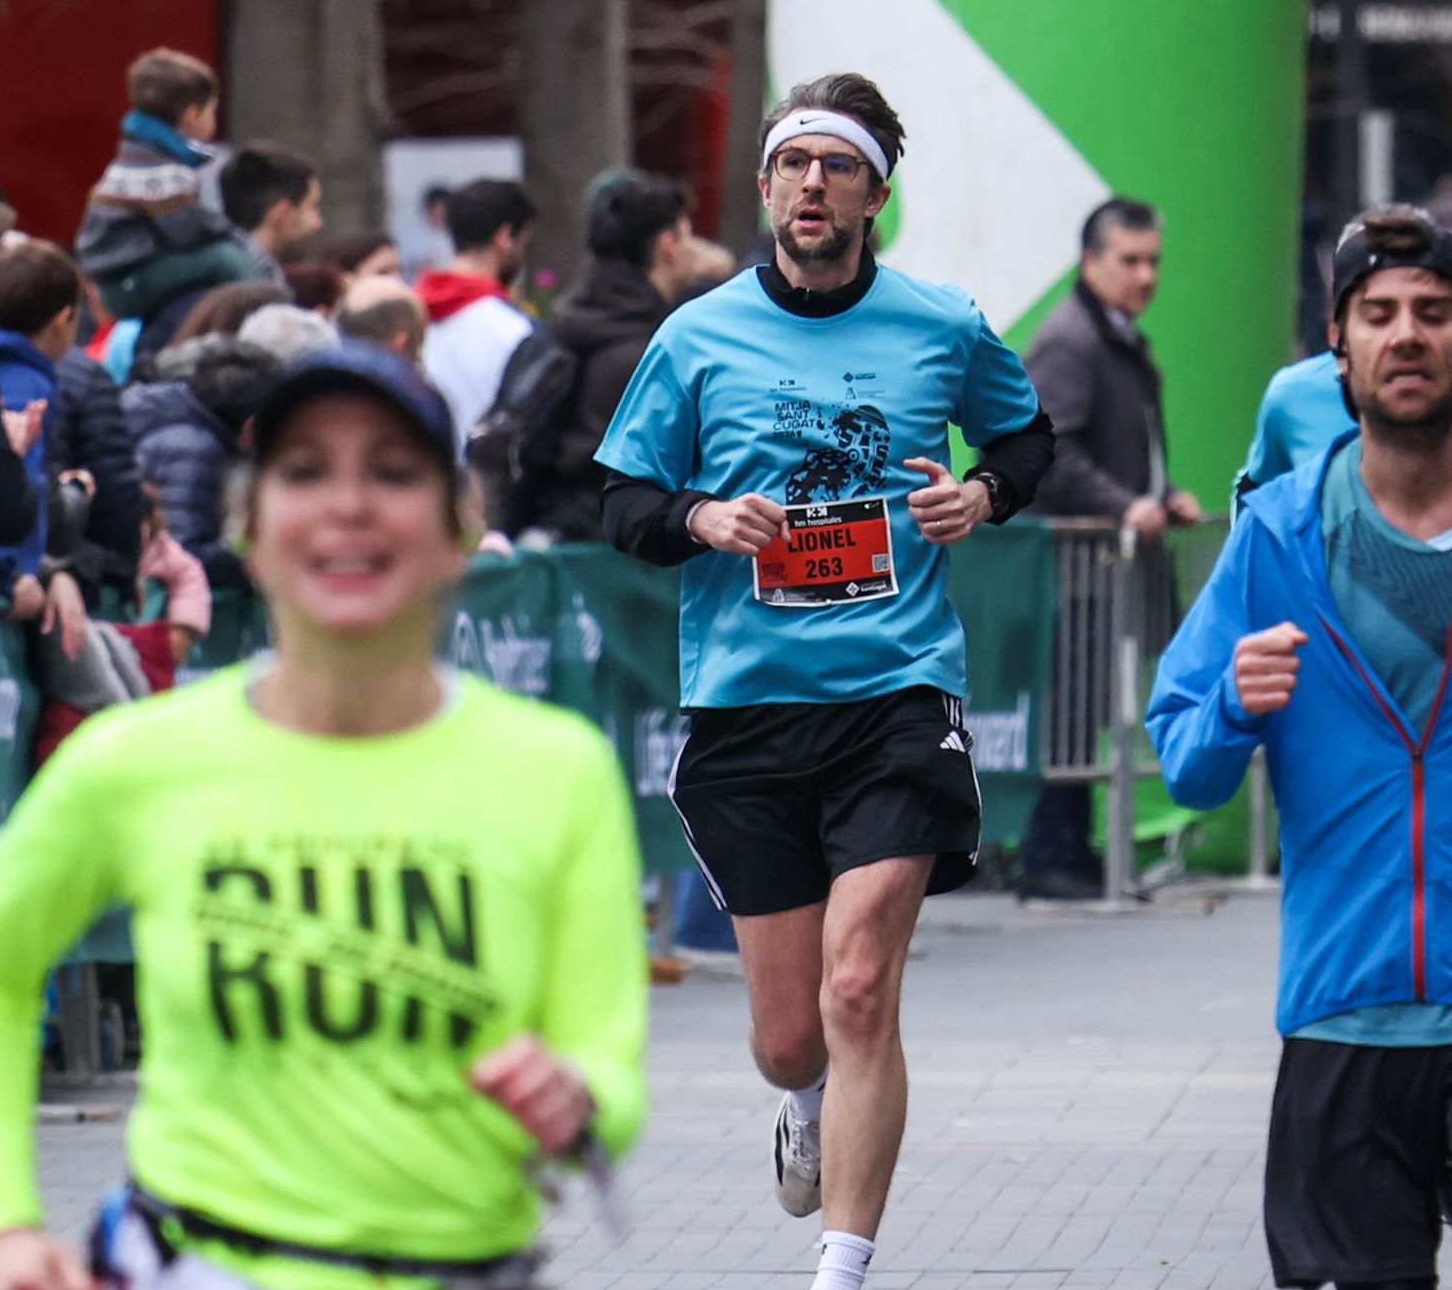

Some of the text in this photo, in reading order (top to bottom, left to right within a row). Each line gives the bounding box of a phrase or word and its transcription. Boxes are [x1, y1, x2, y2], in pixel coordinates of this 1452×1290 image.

[775, 400, 810, 412] MITJA
[777, 410, 809, 422] SANT
[773, 419, 815, 430] CUGAT
[787, 527, 857, 553] LIONEL
[805, 556, 845, 580] 263
